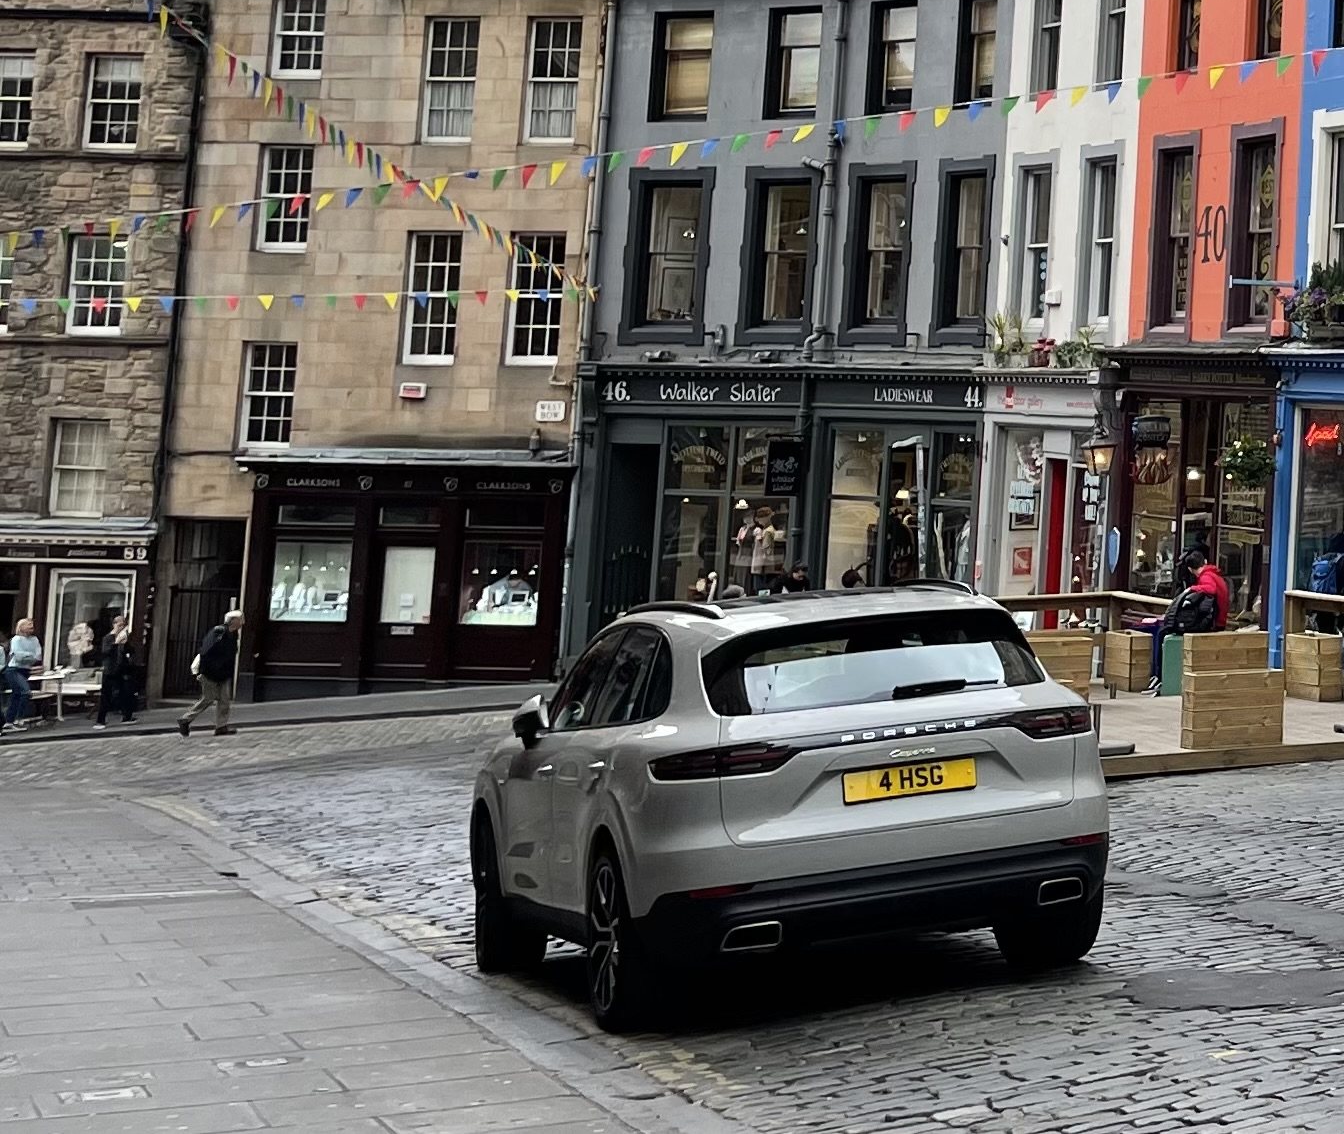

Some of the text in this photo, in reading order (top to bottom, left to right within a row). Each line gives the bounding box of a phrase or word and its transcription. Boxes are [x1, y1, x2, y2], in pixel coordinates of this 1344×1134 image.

[1196, 205, 1227, 263] 40
[601, 381, 781, 402] 46. Walker Slater
[873, 385, 983, 408] LADIESWEAR 44.
[286, 478, 341, 488] CLARKSONS
[123, 546, 148, 560] 89
[840, 719, 976, 743] PORSCHE
[879, 765, 944, 792] 4 HSG
